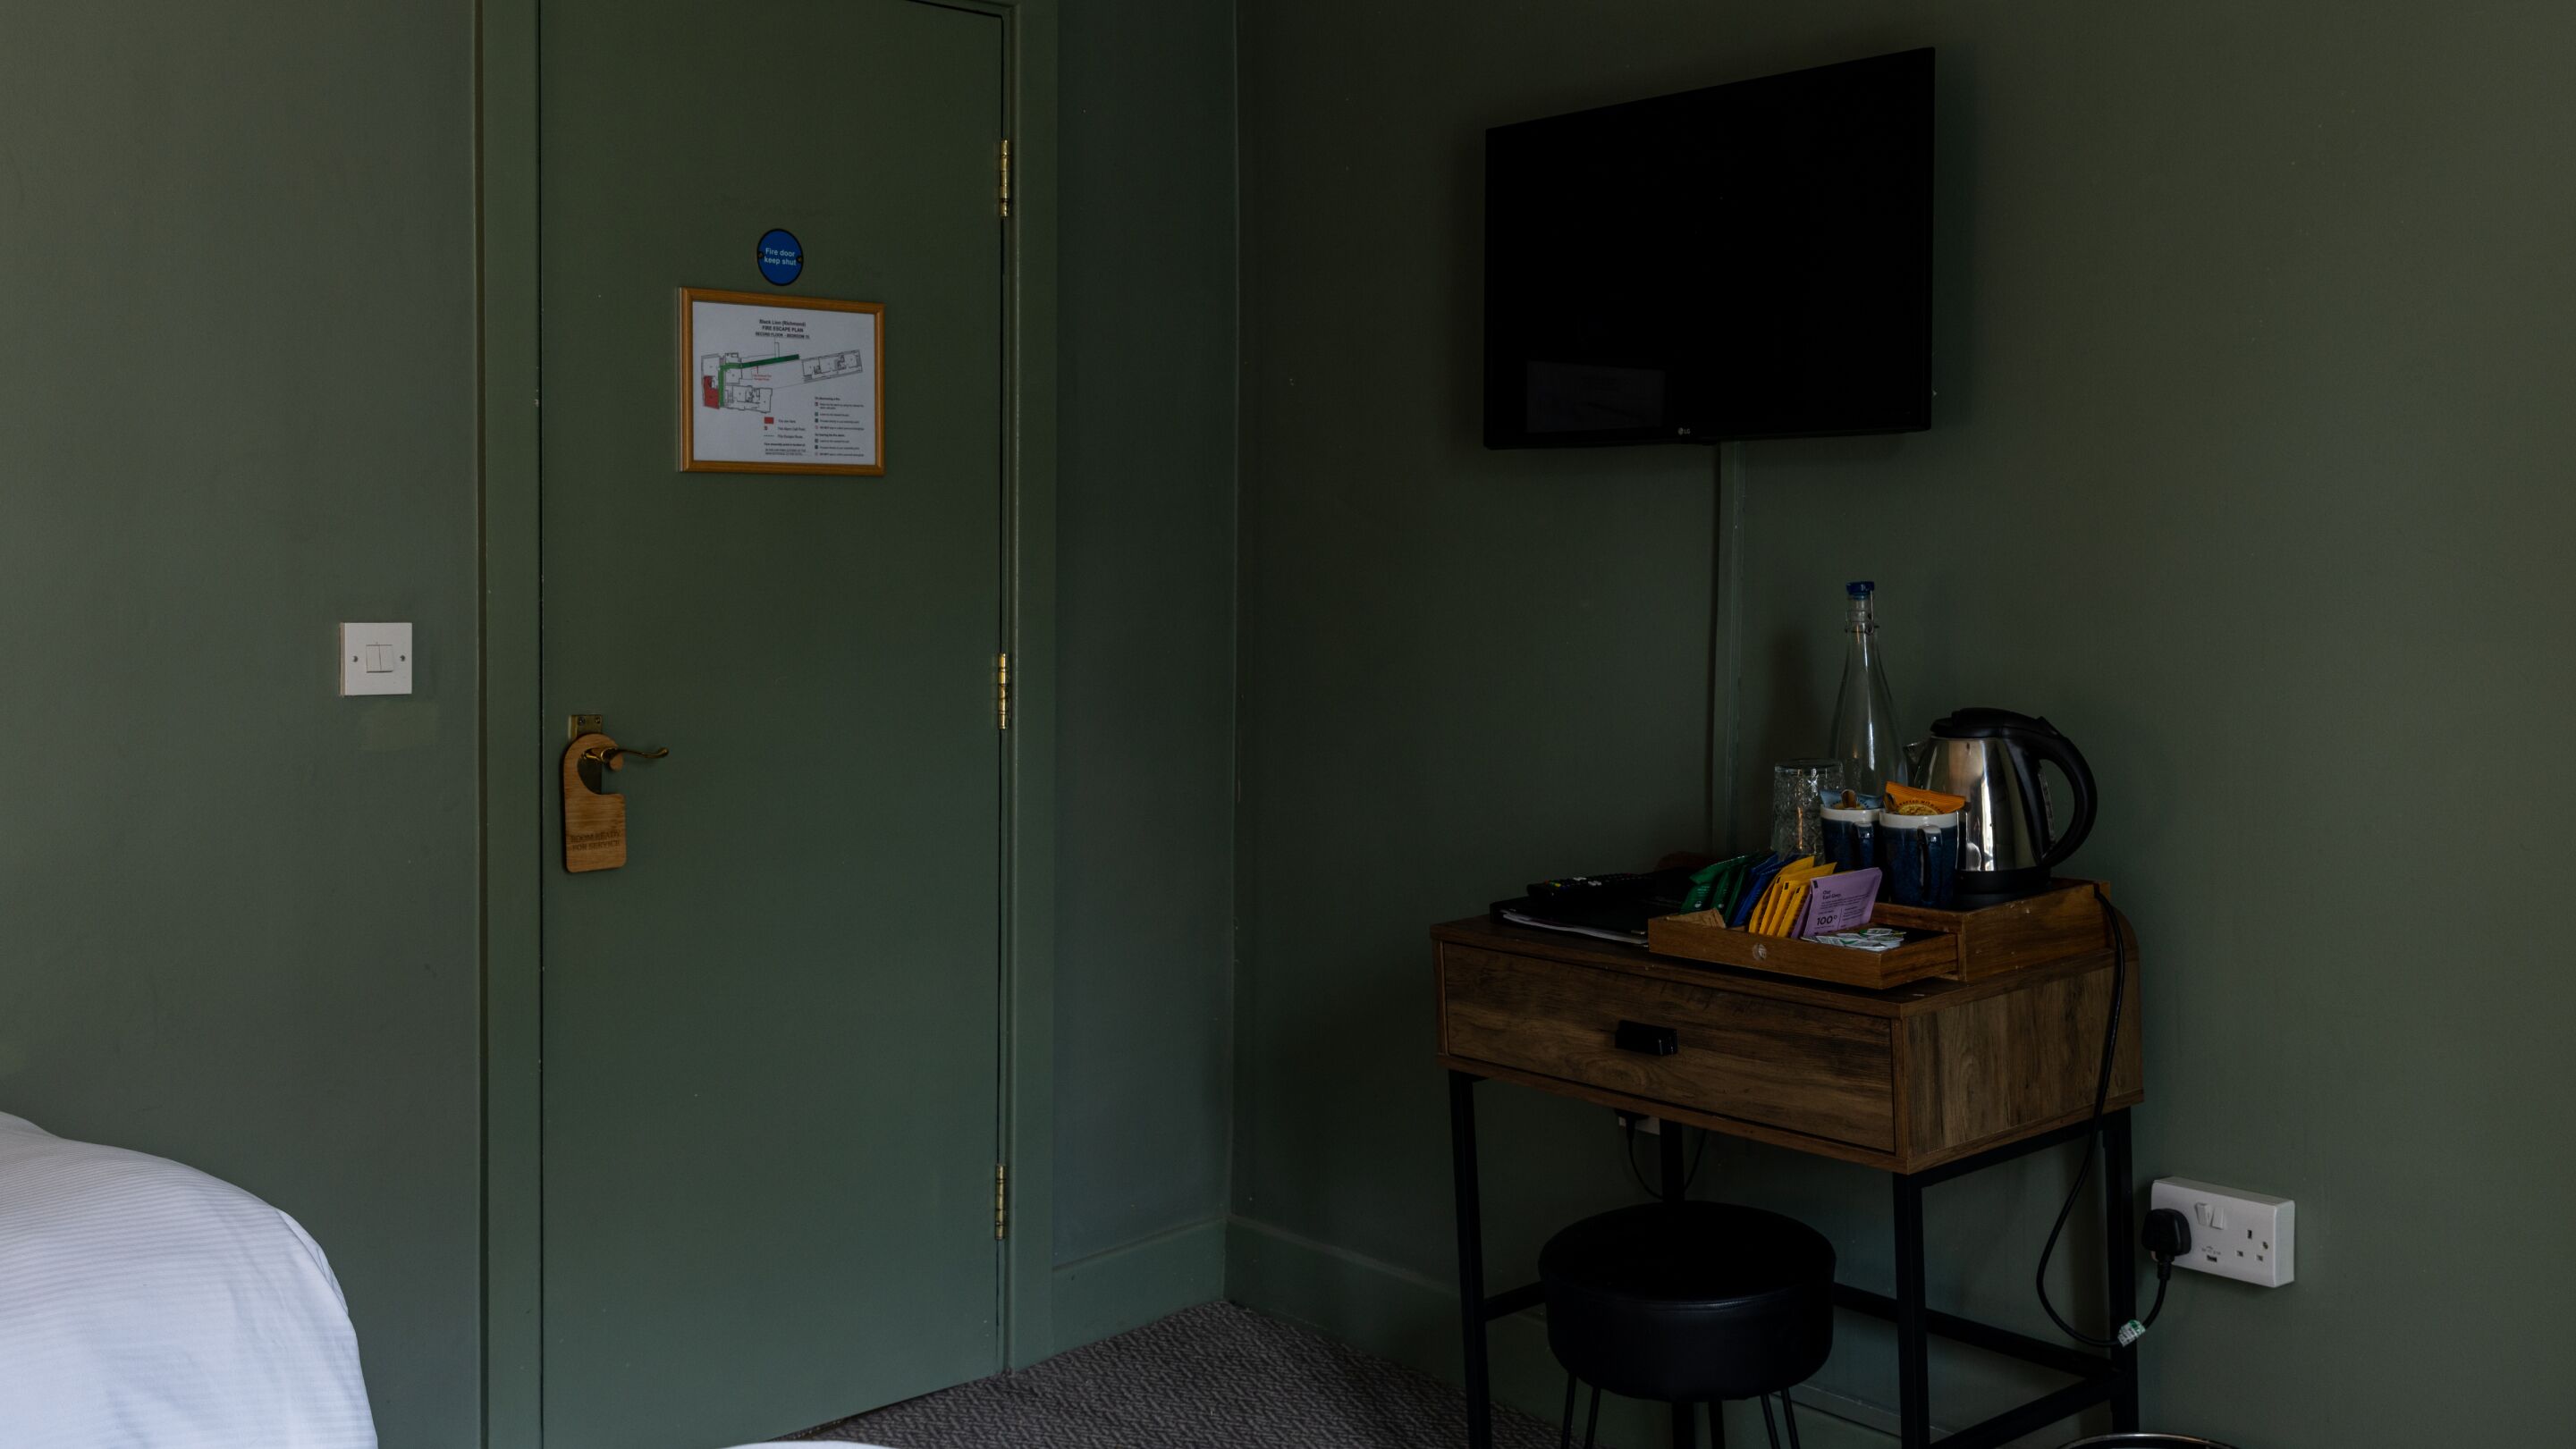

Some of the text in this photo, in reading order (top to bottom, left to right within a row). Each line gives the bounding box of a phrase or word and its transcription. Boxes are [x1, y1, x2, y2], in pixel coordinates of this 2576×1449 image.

[765, 247, 795, 257] Fire door
[764, 256, 797, 266] keep shut
[595, 830, 621, 840] READY
[588, 839, 620, 850] SERVICE
